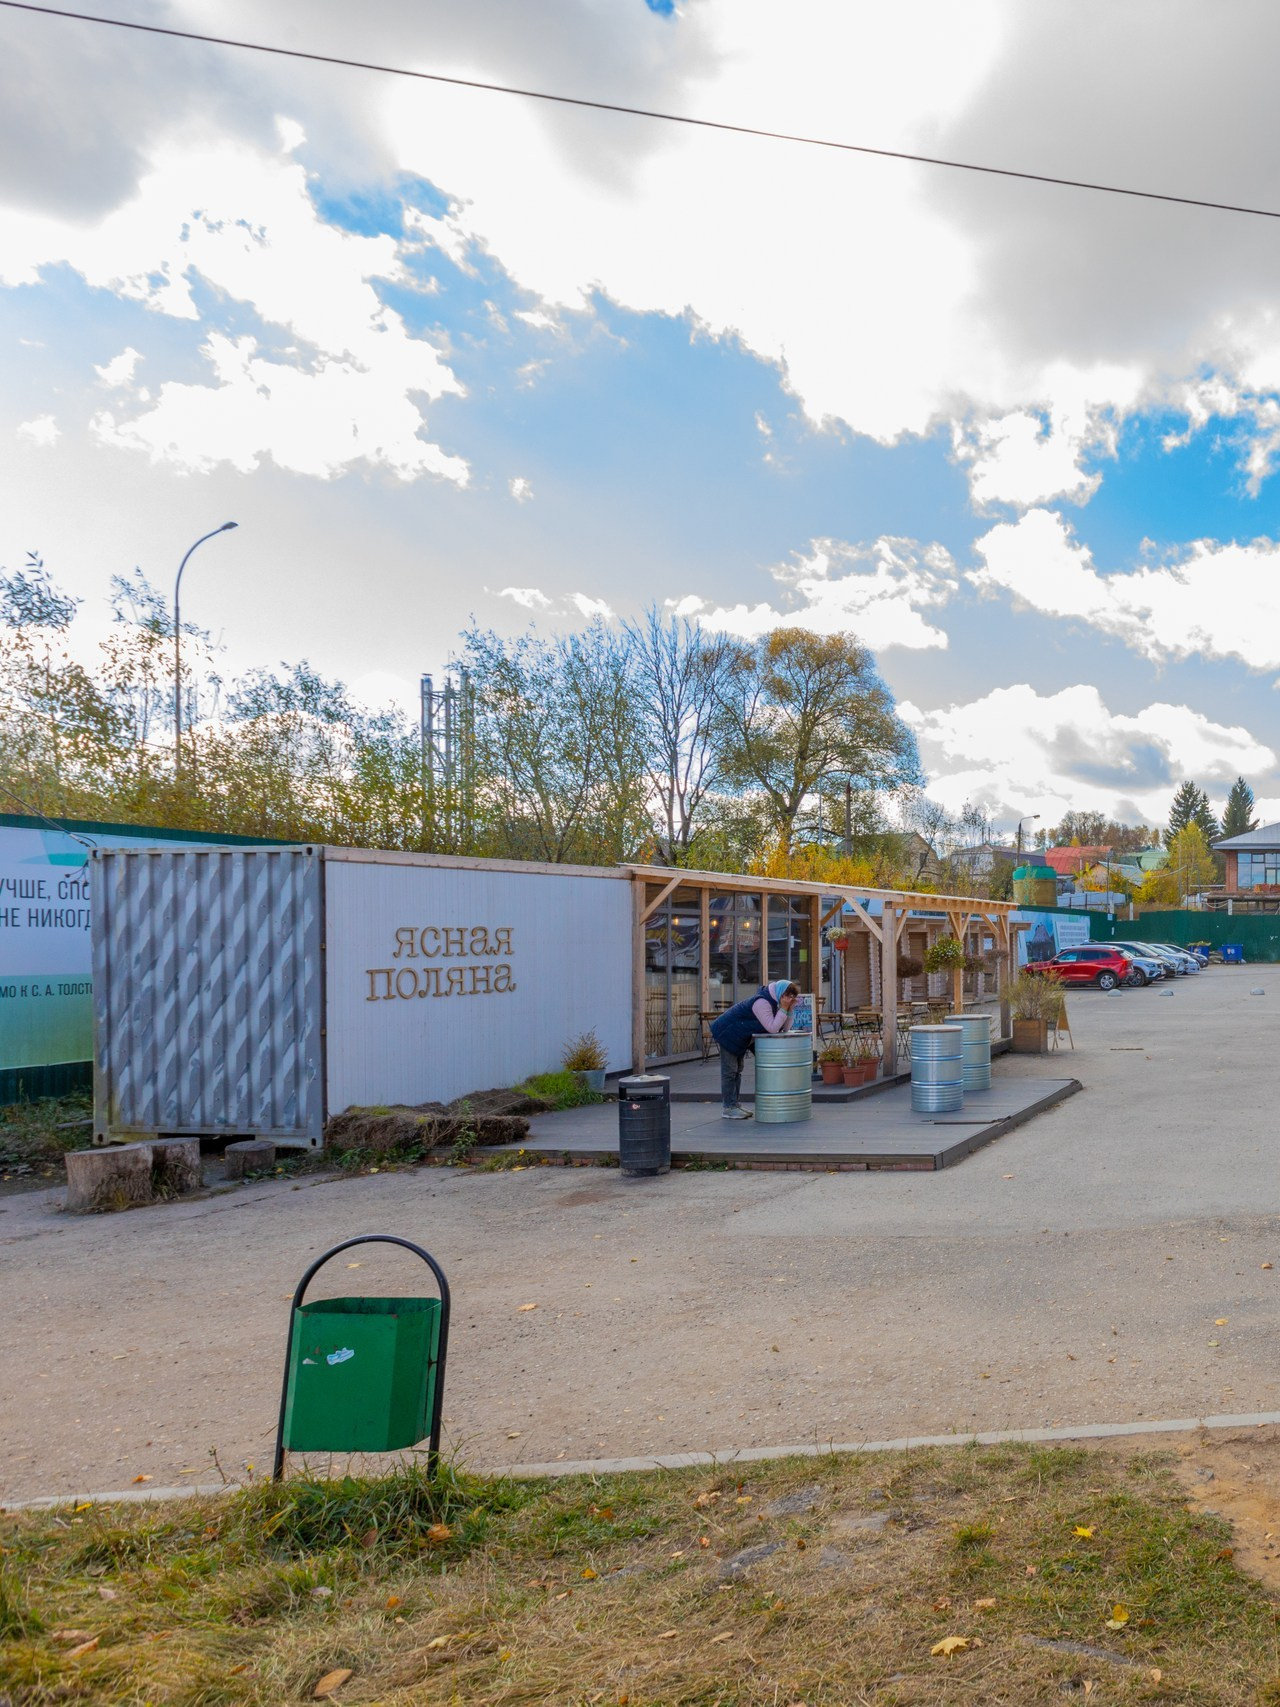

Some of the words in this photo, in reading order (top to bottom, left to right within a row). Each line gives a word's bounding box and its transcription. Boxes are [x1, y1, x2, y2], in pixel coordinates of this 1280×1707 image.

[20, 984, 28, 998] К
[31, 984, 42, 998] С.
[45, 983, 55, 997] А.
